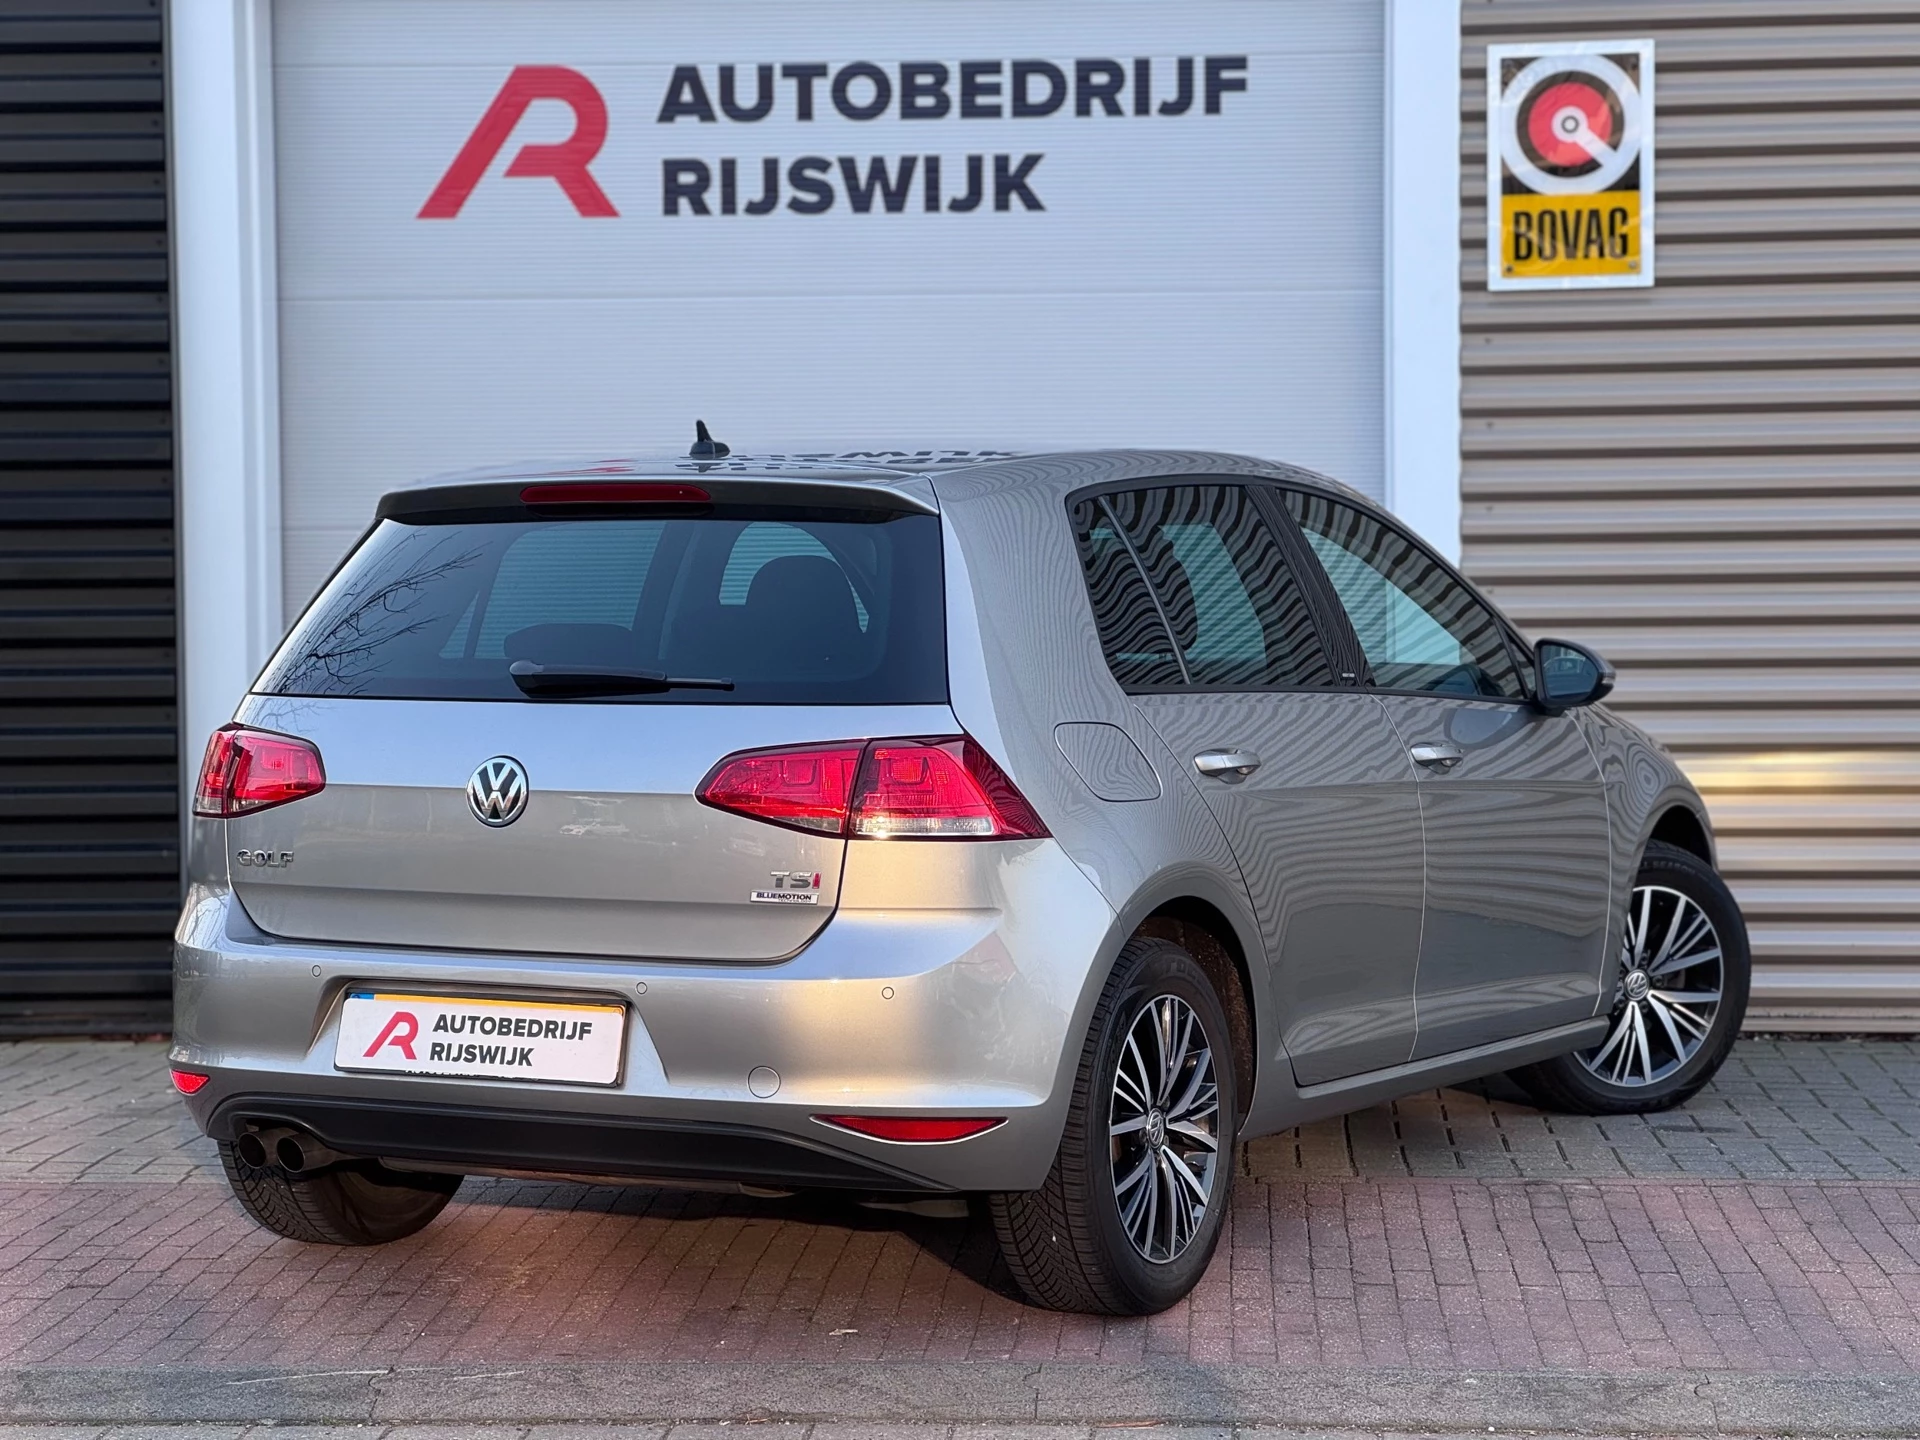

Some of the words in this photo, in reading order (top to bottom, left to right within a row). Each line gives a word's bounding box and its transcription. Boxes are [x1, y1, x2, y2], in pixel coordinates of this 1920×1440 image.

[657, 55, 1248, 122] AUTOBEDRIJF
[661, 154, 1047, 217] RIJSWIJK
[1514, 206, 1628, 261] BOVAG
[236, 848, 294, 868] GOLF
[770, 871, 821, 889] TSI
[756, 892, 812, 900] BLUEMOTION
[432, 1014, 592, 1041] AUTOBEDRIJF
[429, 1042, 535, 1067] RIJSWIJK
